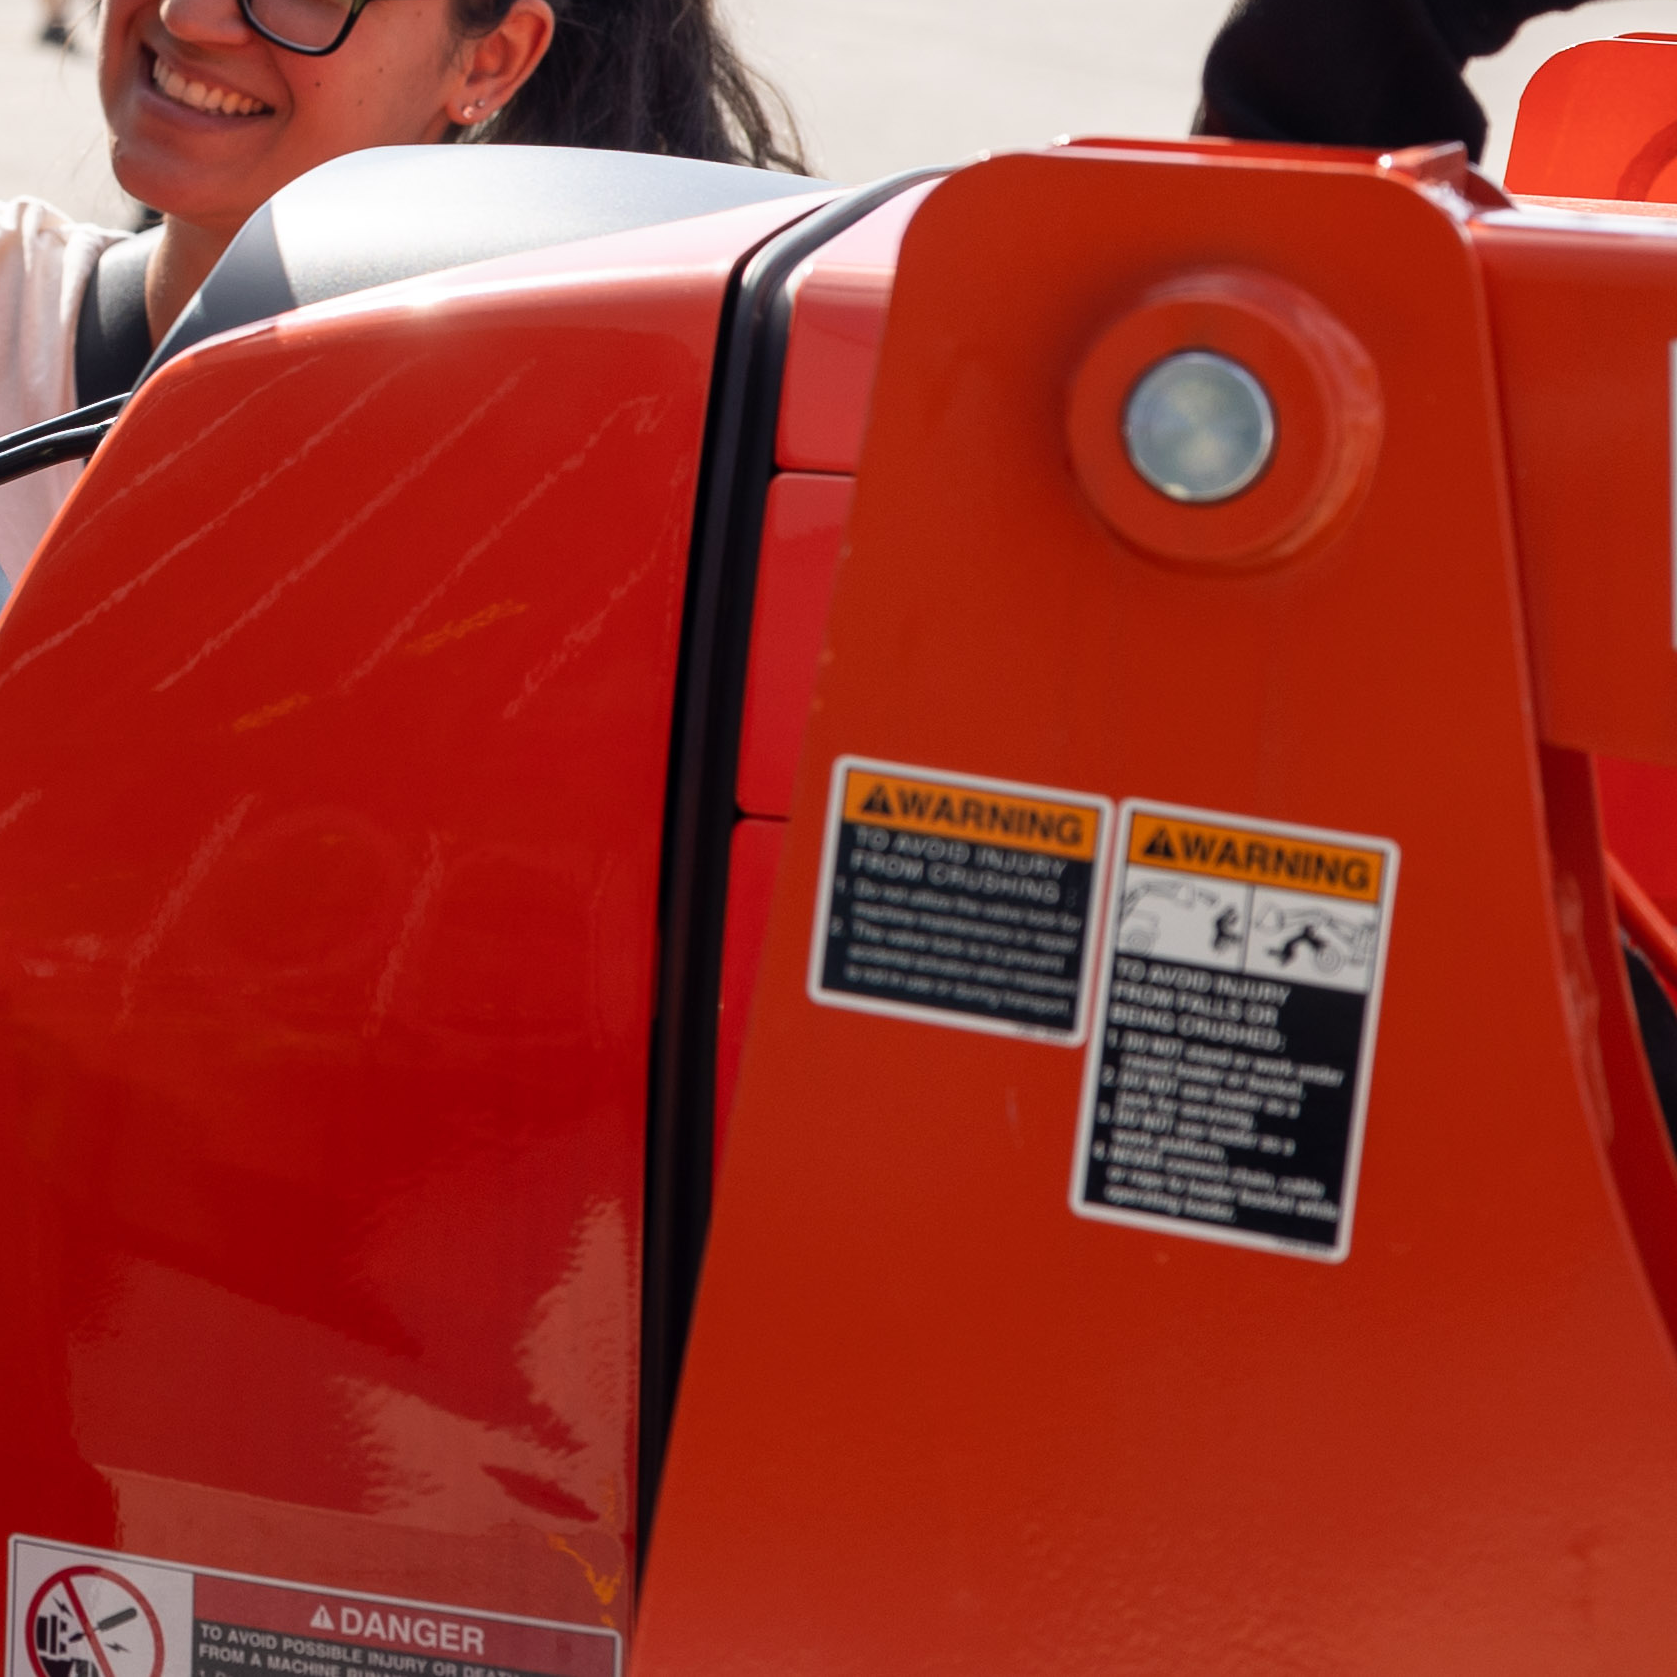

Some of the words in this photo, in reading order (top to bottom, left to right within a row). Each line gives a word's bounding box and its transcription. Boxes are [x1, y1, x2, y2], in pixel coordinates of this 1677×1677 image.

[893, 786, 1084, 848] WARNING
[848, 848, 925, 883] FROM
[852, 825, 891, 853] TO
[890, 831, 972, 866] AVOID
[973, 844, 1068, 882] INJURY
[1175, 829, 1373, 892] WARNING
[1110, 978, 1175, 1010] FROM
[1174, 989, 1243, 1022] FALLS
[1242, 1001, 1279, 1028] OR
[1113, 955, 1147, 983] TO
[1146, 961, 1213, 995] AVOID
[1211, 972, 1292, 1008] INJURY
[1107, 1000, 1177, 1034] BEING
[200, 1623, 223, 1642] TO
[226, 1627, 278, 1651] AVOID
[281, 1635, 364, 1664] POSSIBLE
[367, 1649, 427, 1674] INJURY
[431, 1659, 456, 1677] OR
[340, 1606, 485, 1656] DANGER
[198, 1641, 245, 1665] FROM
[249, 1649, 261, 1668] A
[267, 1652, 339, 1677] MACHINE
